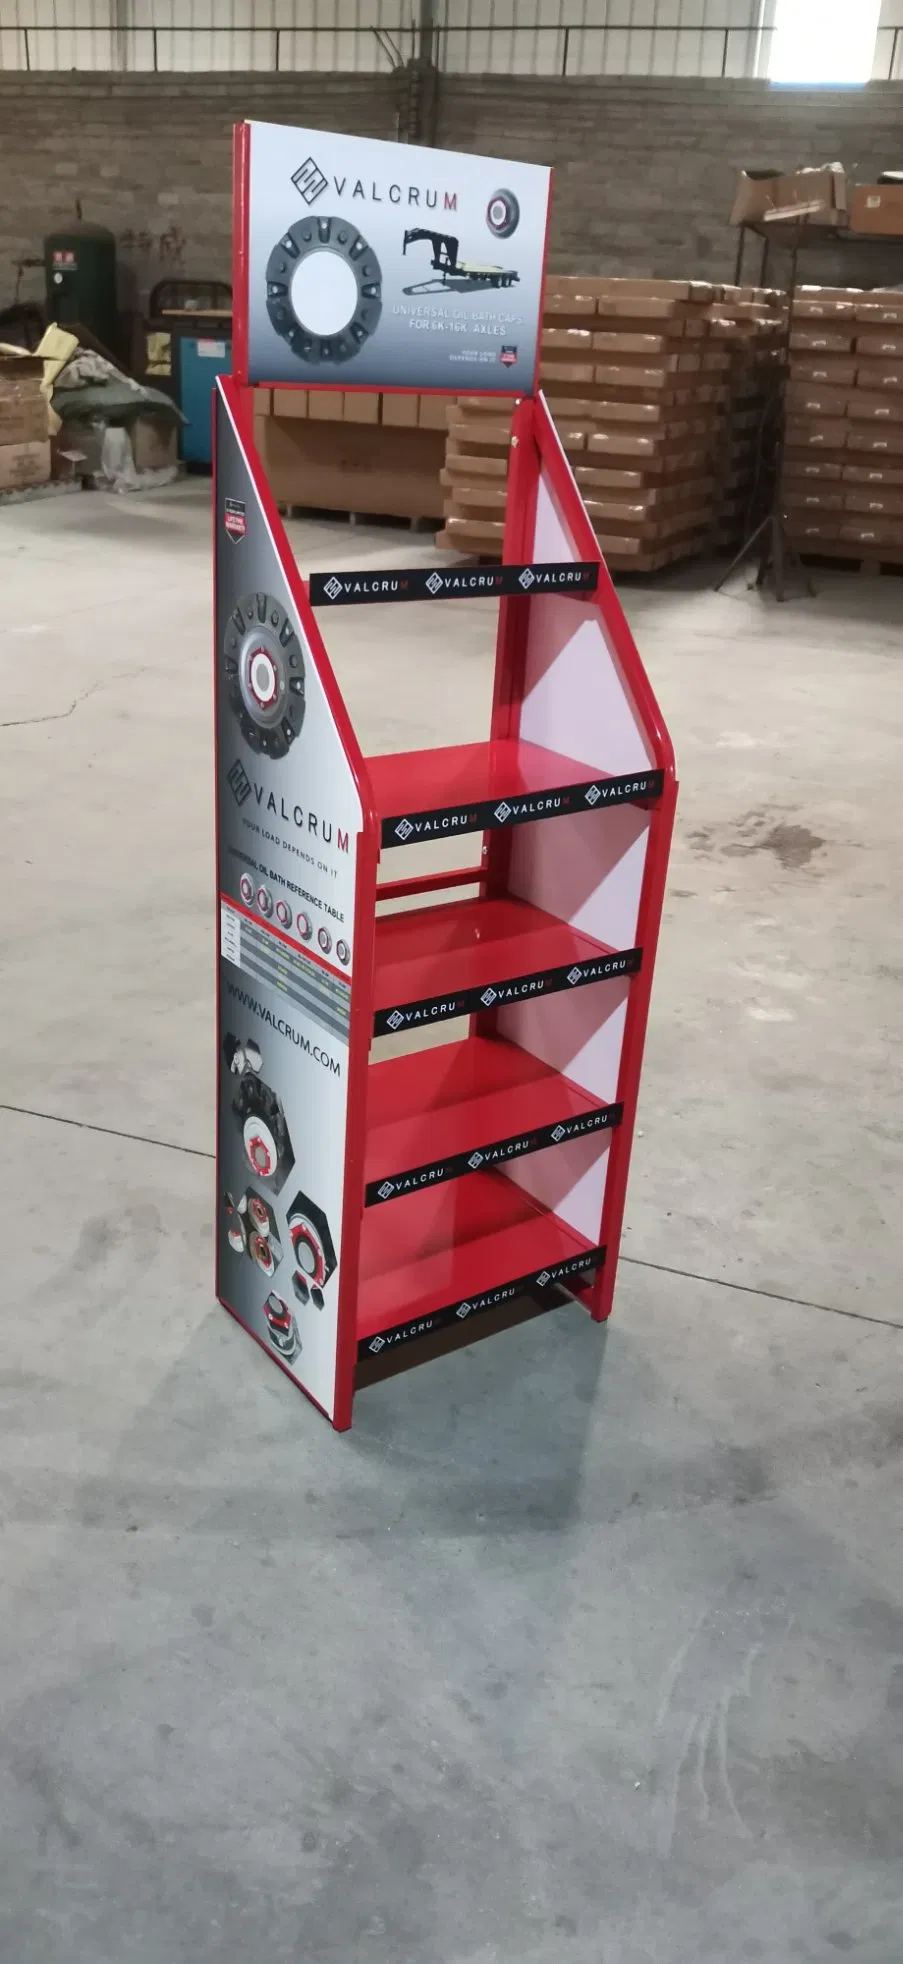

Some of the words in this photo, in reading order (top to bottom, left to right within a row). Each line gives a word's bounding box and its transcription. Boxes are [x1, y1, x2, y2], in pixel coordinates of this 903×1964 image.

[333, 175, 458, 211] VALCRUM
[392, 304, 449, 318] UNIVERSAL
[409, 319, 429, 330] FOR
[431, 321, 467, 333] 6K-16K
[473, 324, 506, 336] AXLES
[344, 580, 408, 593] VALCRUM
[444, 575, 503, 588] VALCRUM
[536, 571, 590, 584] VALCRUM
[254, 782, 349, 854] VALCRUM
[415, 813, 477, 832] VALCRUM
[512, 796, 570, 815] VALCRUM
[601, 781, 655, 798] VALCRUM
[241, 817, 260, 833] YOUR
[261, 828, 280, 845] LOAD
[282, 841, 315, 866] DEPENDS
[317, 861, 328, 873] ON
[330, 869, 338, 879] IT
[259, 863, 269, 877] OIL
[269, 870, 286, 887] BATH
[286, 880, 322, 910] REFERENCE
[323, 903, 345, 923] TABLE
[405, 1000, 464, 1021] VALCRUM
[498, 978, 553, 999] VALCRUM
[582, 958, 634, 978] VALCRUM
[226, 980, 341, 1077] WWW.VALCRUM.COM
[386, 1317, 441, 1344] VALCRU
[472, 1285, 523, 1310] VALCRU
[551, 1256, 597, 1279] VALCRU
